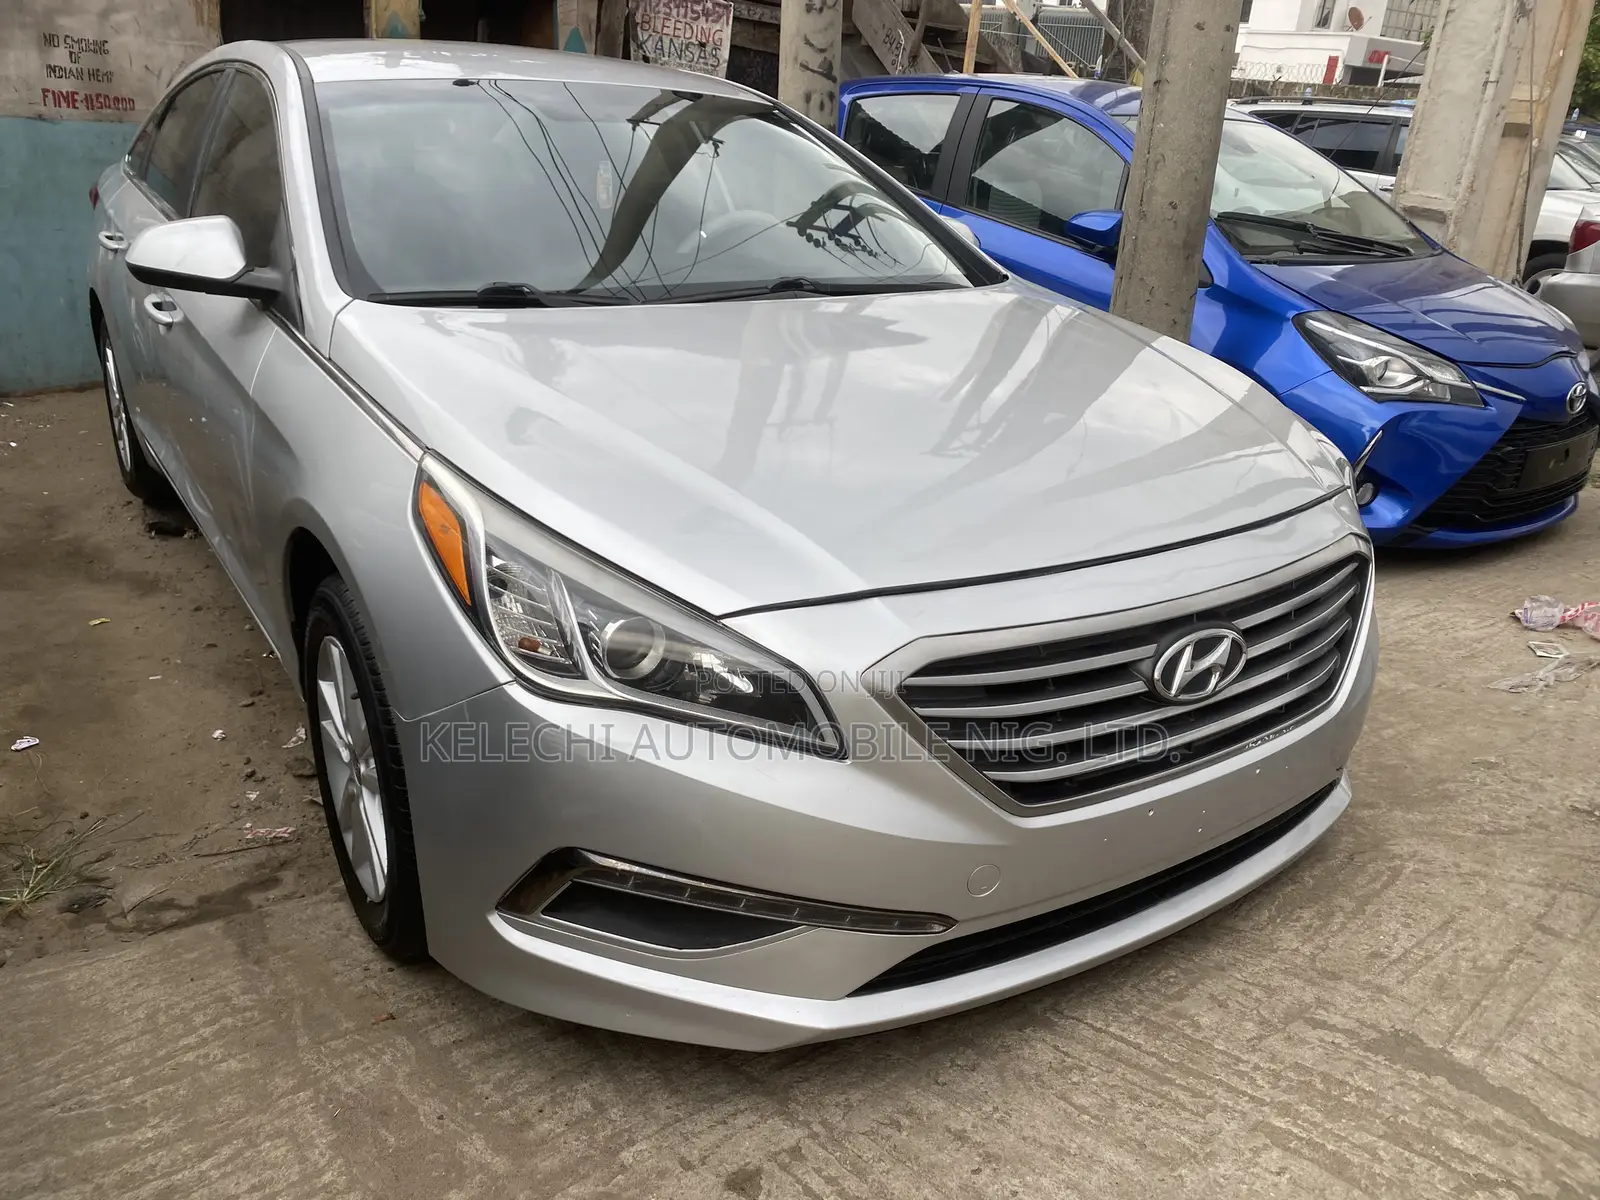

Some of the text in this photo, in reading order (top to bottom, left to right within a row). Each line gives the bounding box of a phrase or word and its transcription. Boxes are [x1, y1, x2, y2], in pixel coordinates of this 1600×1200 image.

[640, 13, 724, 47] BLEEDING
[43, 32, 109, 55] NO SMOKING
[637, 31, 722, 69] KANSAS
[68, 50, 82, 65] OF
[45, 63, 84, 81] INDIAN
